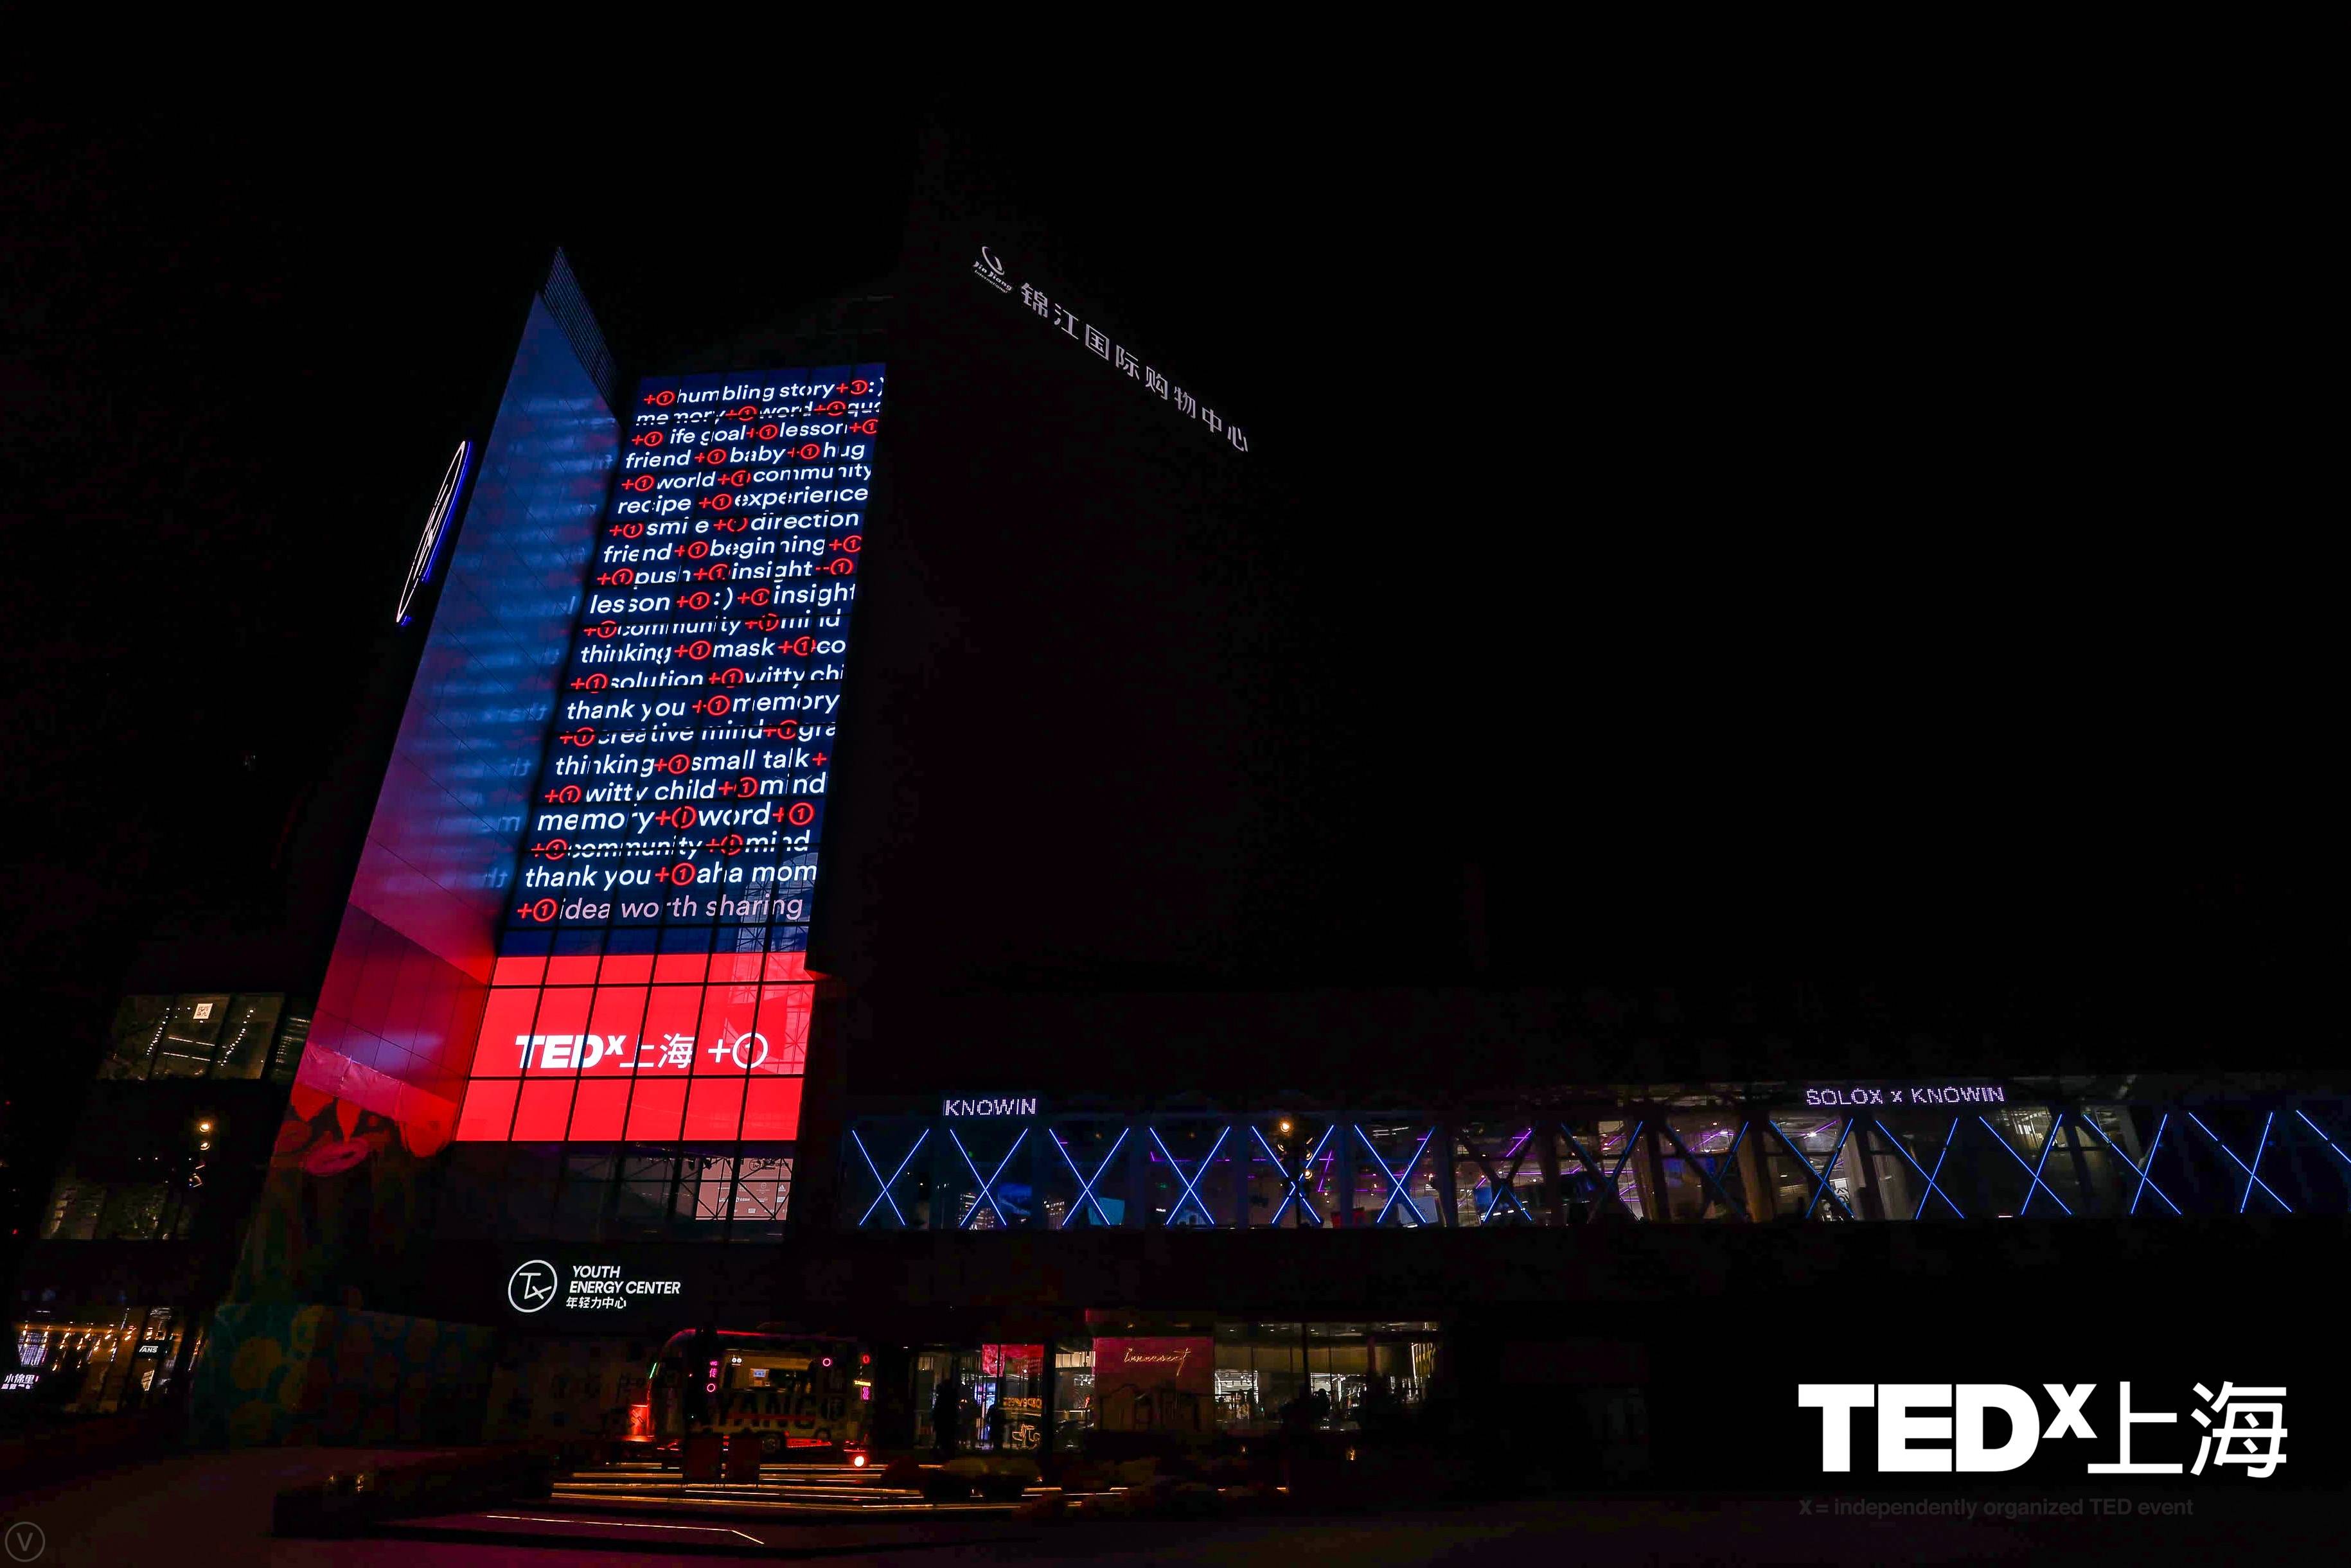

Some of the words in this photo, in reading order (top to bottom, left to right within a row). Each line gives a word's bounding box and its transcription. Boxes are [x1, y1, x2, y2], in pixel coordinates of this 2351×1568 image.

[1022, 283, 1248, 452] 锦江国际购物中心
[677, 384, 774, 403] humbling
[779, 383, 835, 398] story
[760, 401, 813, 419] word
[670, 428, 696, 444] ife
[779, 421, 847, 437] lesson
[626, 450, 691, 468] friend
[730, 445, 786, 464] baby
[657, 471, 716, 489] world
[753, 463, 871, 482] community
[617, 495, 691, 516] recipe
[734, 486, 868, 509] experience
[646, 516, 709, 536] smie
[751, 510, 858, 530] direction
[604, 543, 673, 563] friend
[710, 535, 826, 559] beginning
[634, 565, 691, 590] push
[732, 559, 813, 583] insight
[590, 594, 670, 614] lesson
[774, 582, 856, 606] insight
[581, 642, 672, 665] thinking
[713, 637, 776, 658] mask
[817, 640, 846, 655] co
[611, 669, 704, 688] solution
[745, 665, 805, 689] witty
[567, 699, 635, 720] thank
[641, 701, 686, 721] you
[732, 694, 840, 714] memory
[556, 753, 655, 777] thinking
[691, 749, 756, 771] small
[763, 748, 810, 769] talk
[585, 781, 648, 806] witty
[655, 779, 716, 800] child
[698, 802, 772, 827] word
[568, 835, 703, 860] community
[526, 865, 598, 887] thank
[603, 869, 652, 892] you
[696, 861, 743, 884] aha
[752, 865, 818, 883] mom
[560, 897, 611, 921] idea
[621, 895, 697, 919] woth
[705, 894, 803, 921] sharing
[945, 1098, 1036, 1116] KNOWIN
[1806, 1088, 1884, 1106] SOLOX
[1911, 1086, 2005, 1103] KNOWIN
[572, 1265, 621, 1278] YOUTH
[569, 1280, 624, 1294] ENERGY
[625, 1281, 681, 1294] CENTER
[565, 1296, 627, 1309] 年轻力中心
